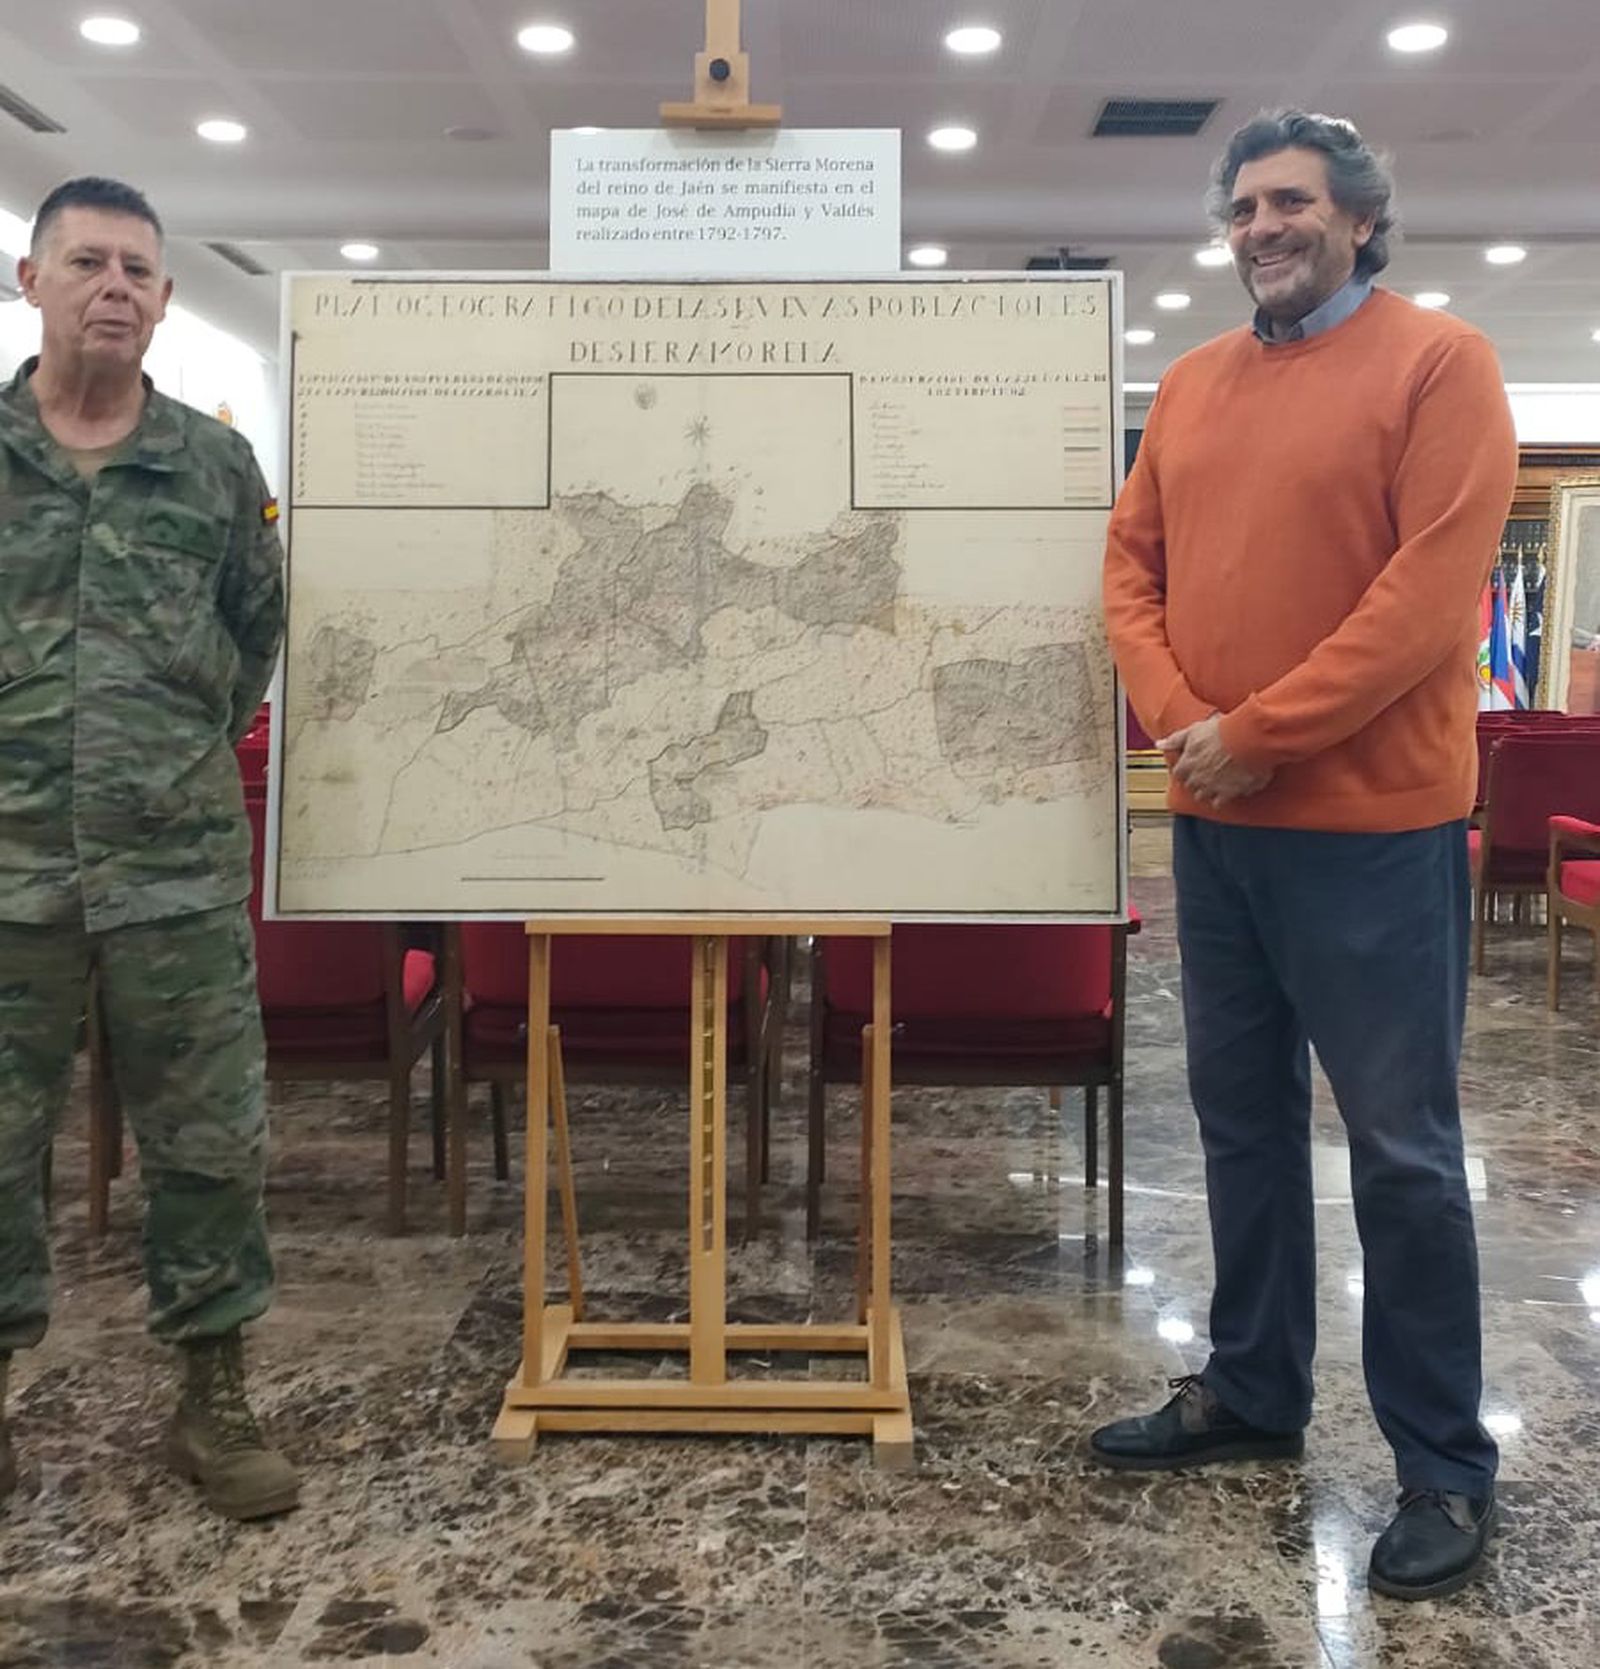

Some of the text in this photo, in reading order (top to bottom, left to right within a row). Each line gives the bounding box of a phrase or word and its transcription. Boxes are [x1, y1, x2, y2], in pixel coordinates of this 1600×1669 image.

[577, 156, 875, 172] La transformación de la Sierra Morena
[576, 180, 875, 196] del reino de Jaén se manifiesta en el
[576, 203, 875, 221] mapa de José de Ampudia y Valdés
[576, 227, 788, 242] realizado entre 1792-1797.
